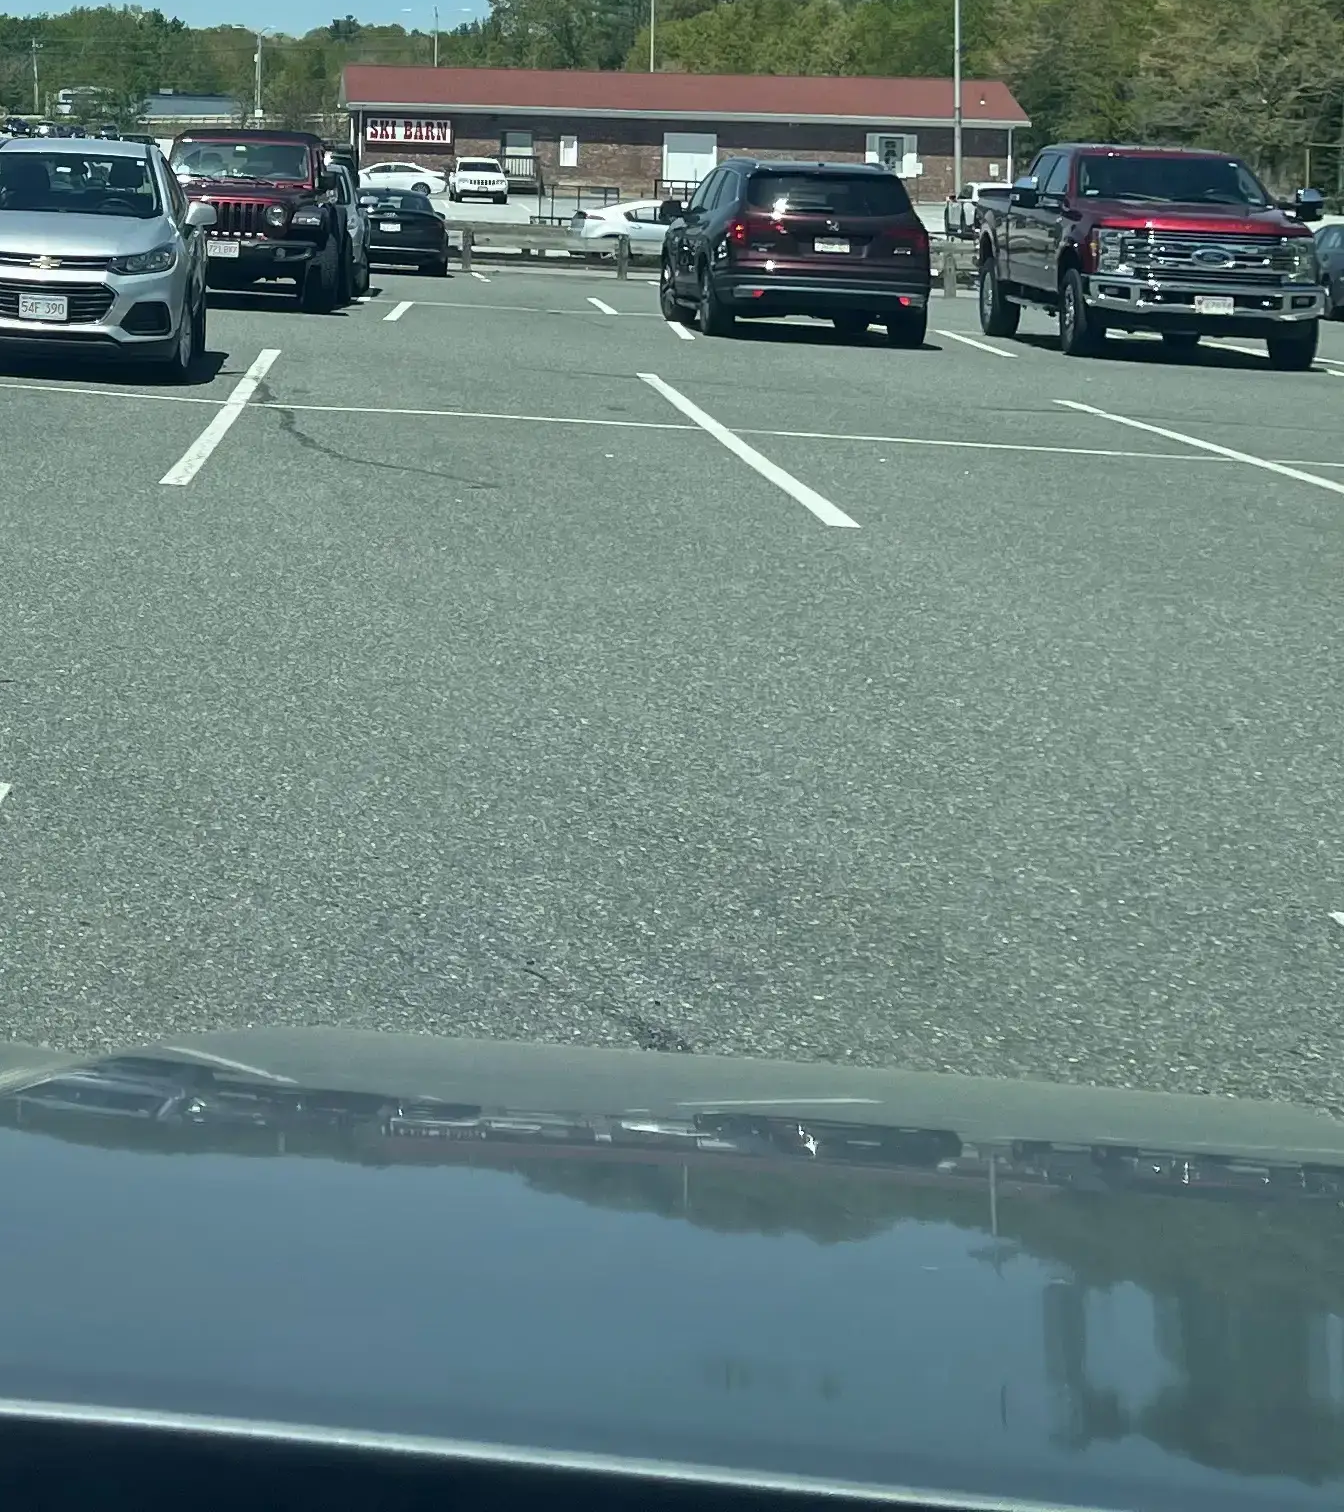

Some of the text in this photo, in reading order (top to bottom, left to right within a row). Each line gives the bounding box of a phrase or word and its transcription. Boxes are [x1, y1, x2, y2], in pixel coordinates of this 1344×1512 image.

[370, 120, 448, 141] SKI BARN
[21, 300, 65, 315] 54F 390
